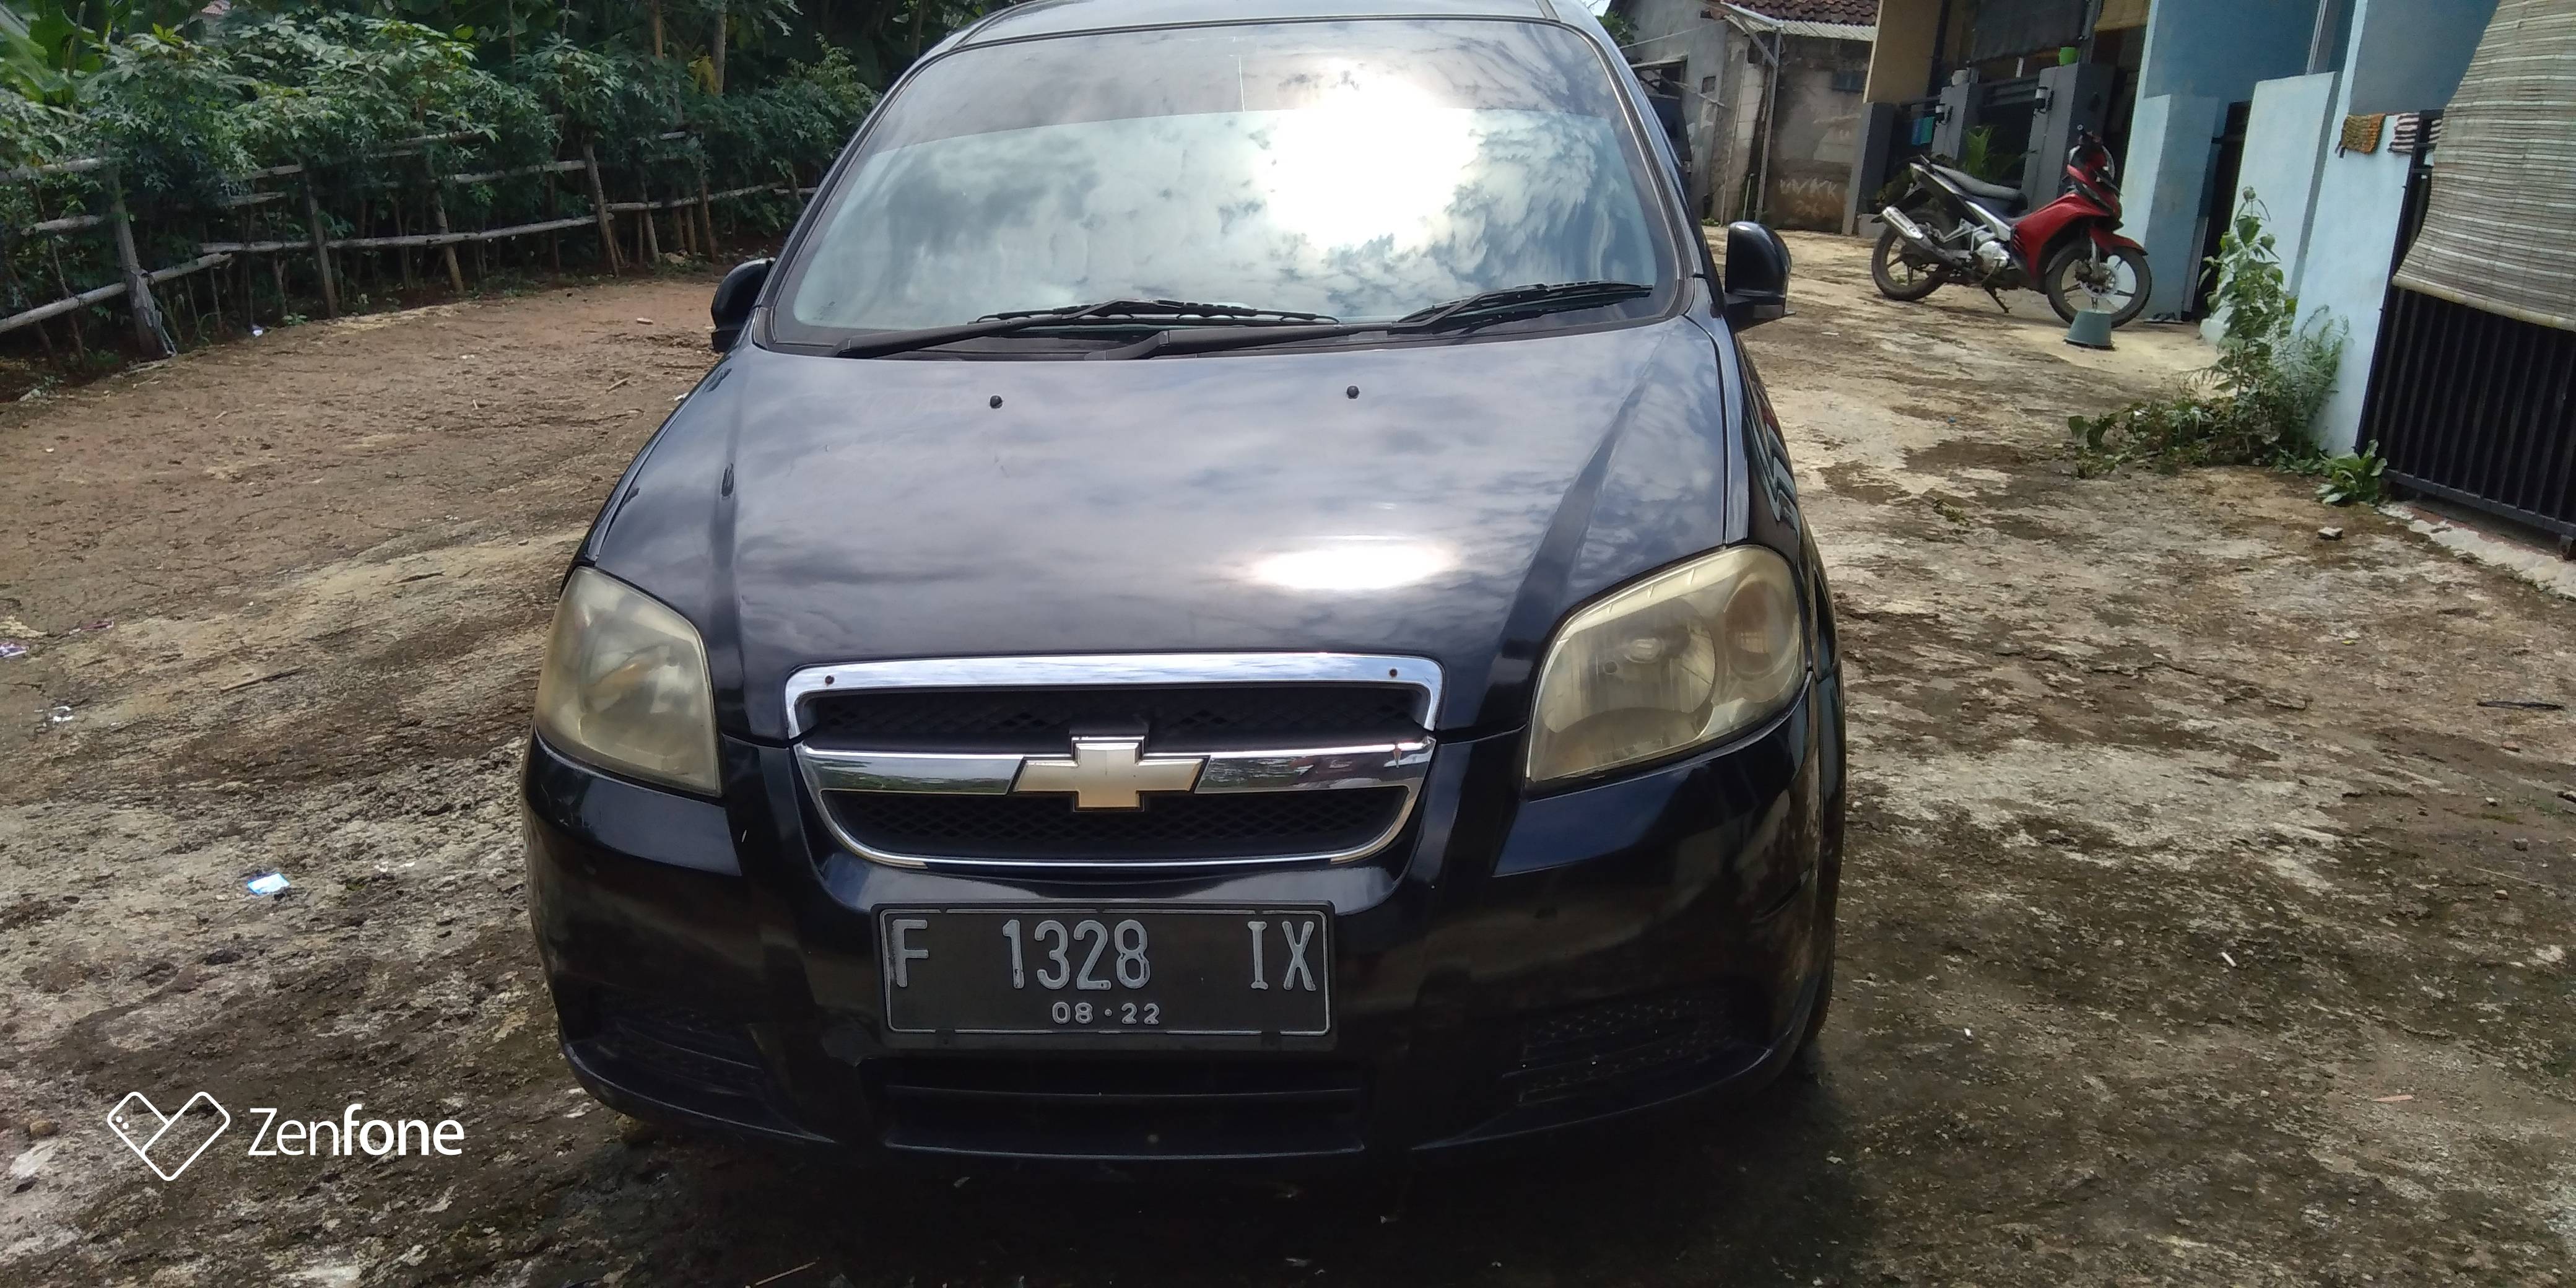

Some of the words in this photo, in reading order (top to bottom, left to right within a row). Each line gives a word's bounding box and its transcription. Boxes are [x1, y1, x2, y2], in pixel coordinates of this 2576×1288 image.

[892, 919, 929, 988] F
[1002, 919, 1151, 990] 1328
[1247, 921, 1315, 991] IX
